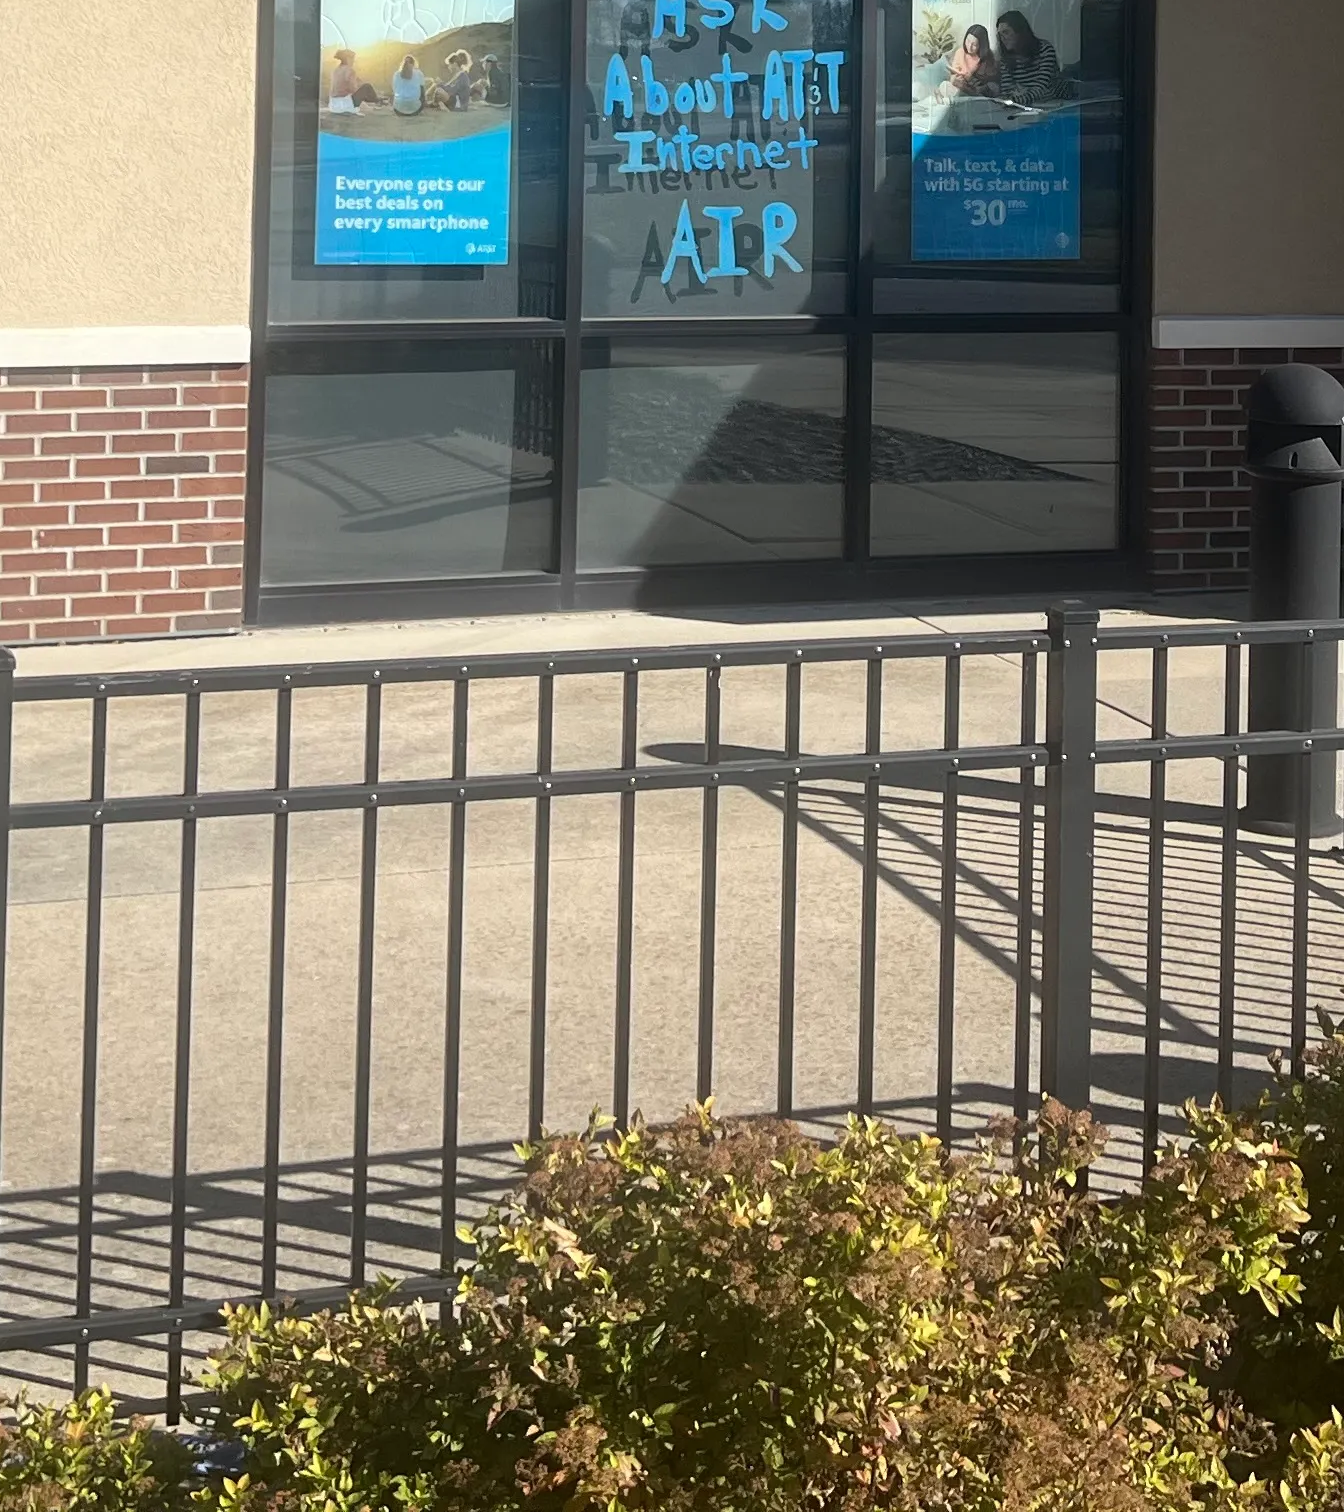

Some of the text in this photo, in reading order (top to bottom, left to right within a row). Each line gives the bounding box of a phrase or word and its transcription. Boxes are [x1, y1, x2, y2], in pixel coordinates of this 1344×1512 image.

[603, 52, 749, 120] About
[612, 123, 819, 174] Internet
[923, 157, 1055, 175] Talk, text, & data
[335, 175, 485, 195] Everyone gets our
[923, 176, 1070, 195] with 5G starting at
[334, 194, 444, 211] best deals on
[963, 198, 1007, 227] $30
[333, 214, 490, 233] every smartphone
[659, 198, 805, 285] AIR
